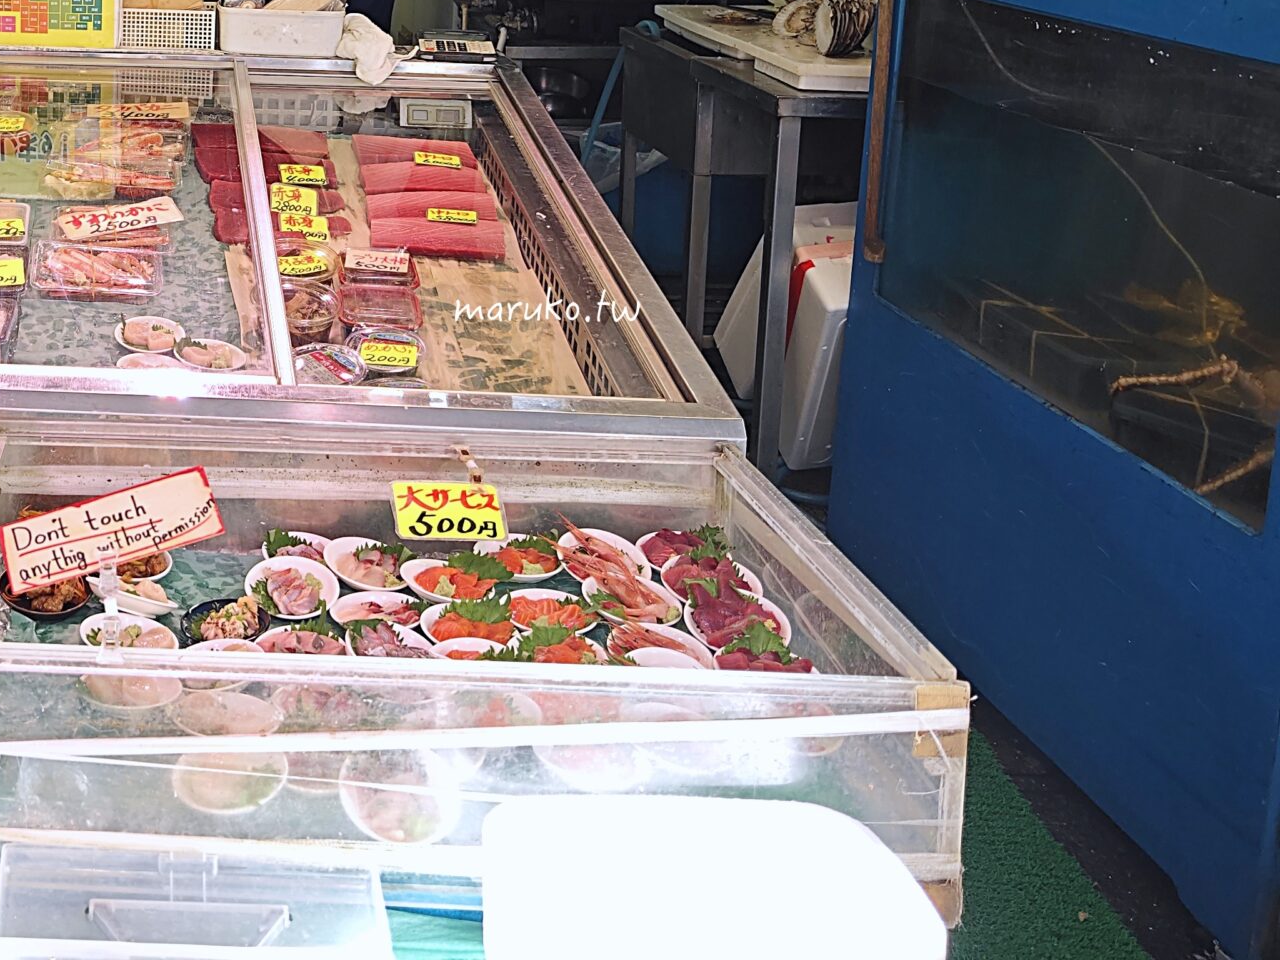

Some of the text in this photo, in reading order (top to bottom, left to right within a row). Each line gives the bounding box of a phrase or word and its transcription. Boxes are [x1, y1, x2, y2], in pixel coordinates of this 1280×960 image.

[281, 165, 314, 176] 赤身
[271, 186, 303, 203] 赤身
[283, 215, 314, 228] 赤身
[354, 261, 401, 272] 500円
[365, 353, 411, 365] 200円
[396, 486, 501, 512] 大サービス
[11, 495, 147, 552] Don't touch
[408, 511, 498, 539] 500円
[19, 497, 216, 583] anythig without permission
